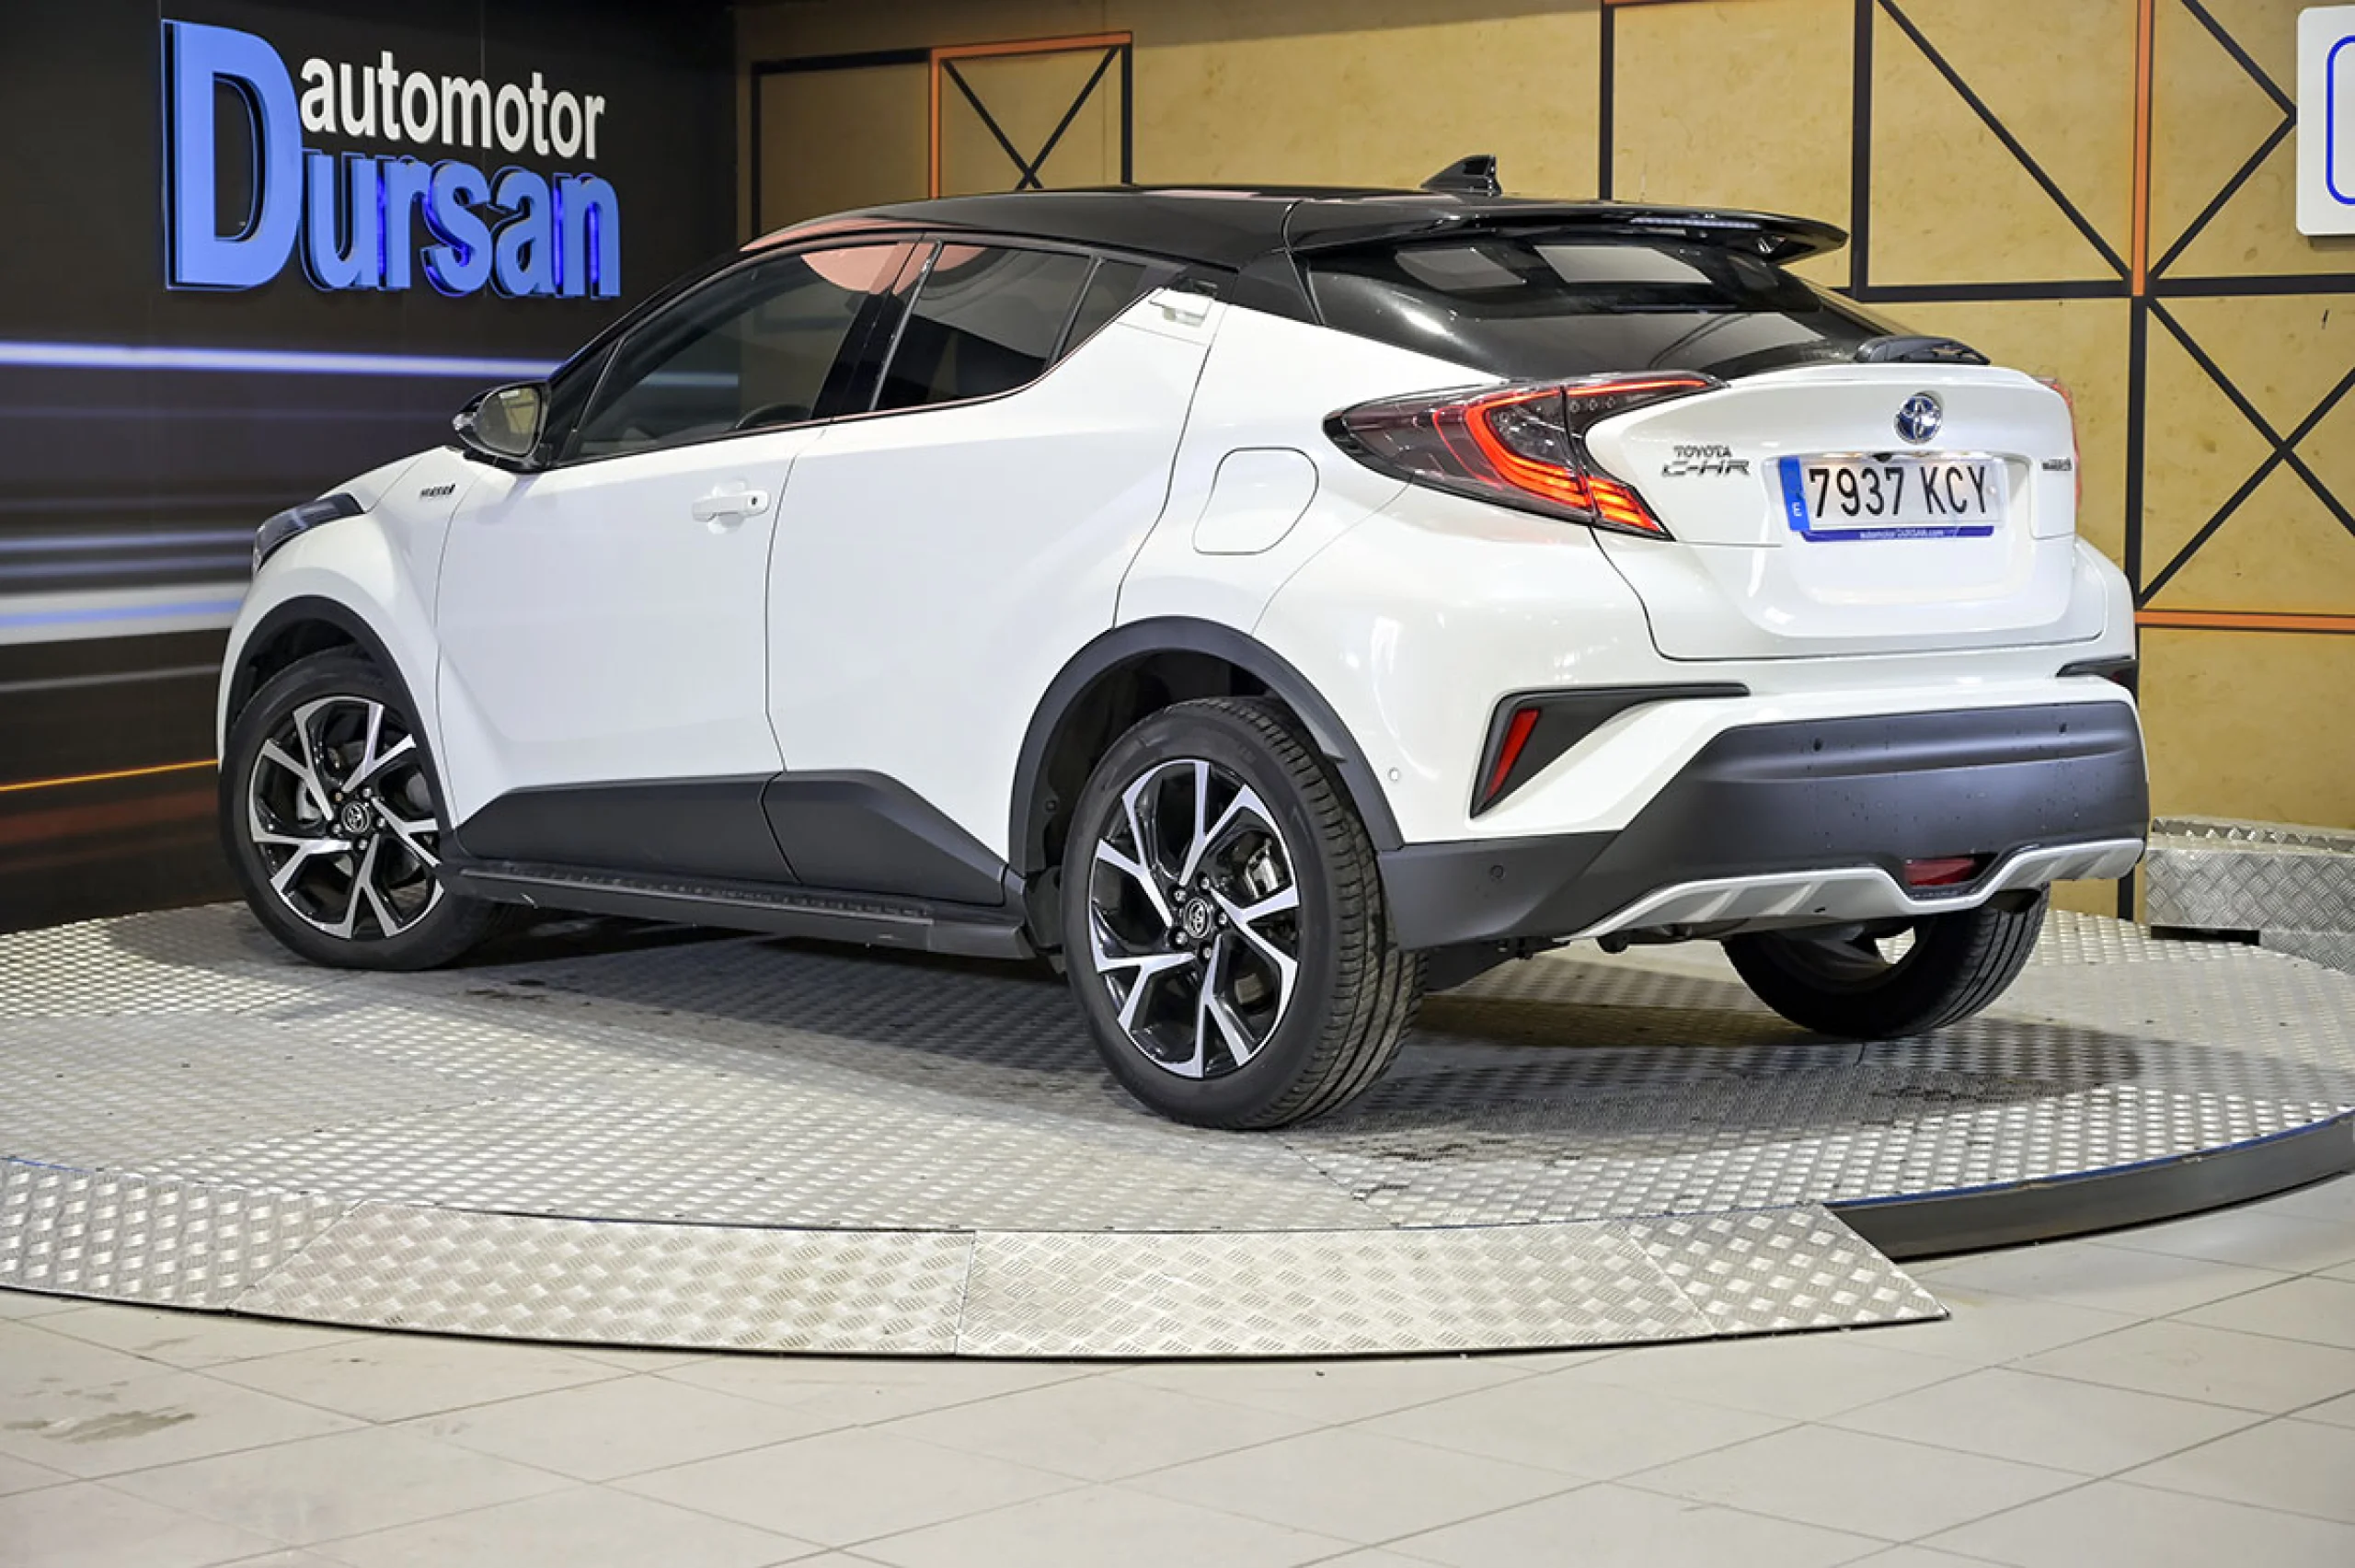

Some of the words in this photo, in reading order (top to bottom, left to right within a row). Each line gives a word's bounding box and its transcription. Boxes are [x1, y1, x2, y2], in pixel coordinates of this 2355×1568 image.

[300, 51, 605, 160] automotor
[161, 18, 621, 299] Dursan
[1661, 460, 1750, 475] C-HR
[1673, 445, 1732, 457] TOYOTA
[1792, 501, 1802, 516] E
[1809, 466, 1903, 518] 7937
[1920, 465, 1985, 514] KCY
